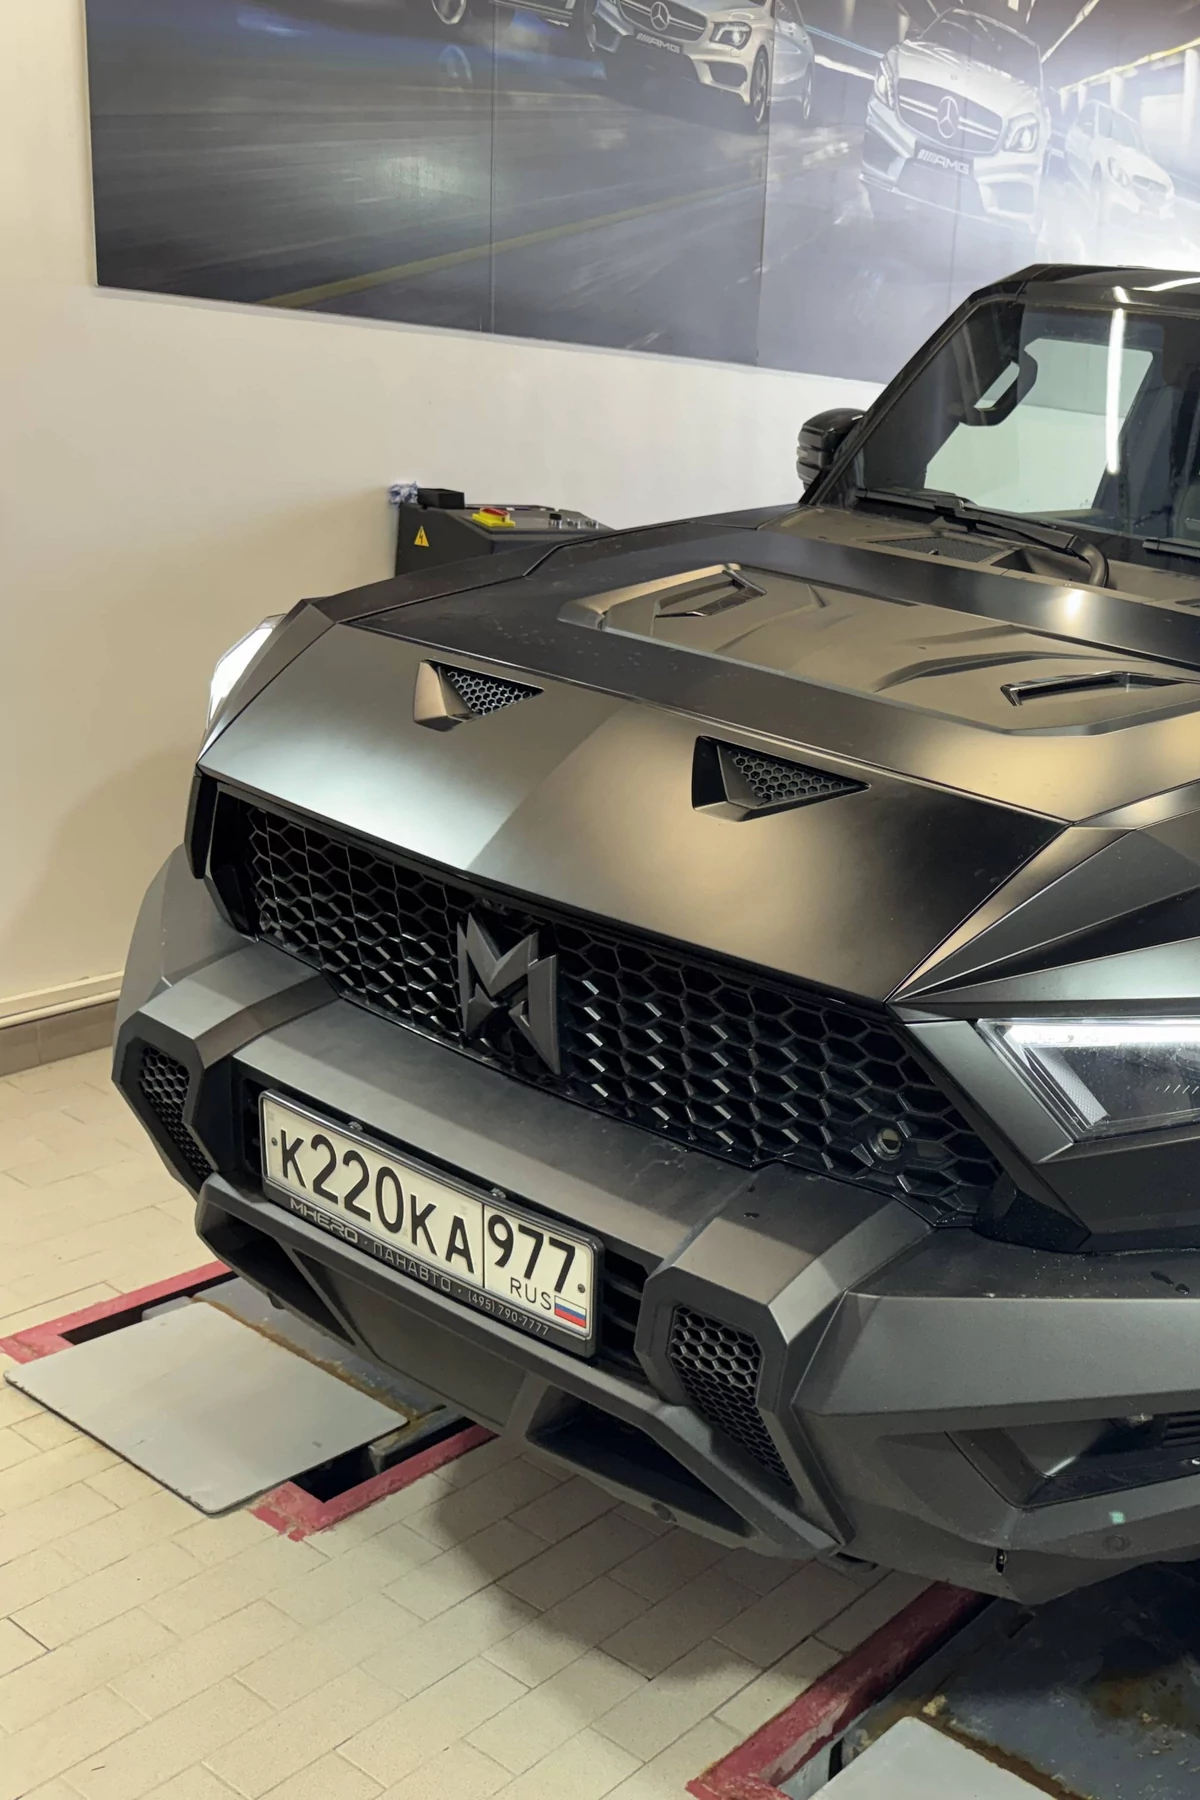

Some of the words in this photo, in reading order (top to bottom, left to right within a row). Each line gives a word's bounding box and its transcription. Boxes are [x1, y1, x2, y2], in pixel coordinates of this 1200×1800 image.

[290, 1197, 359, 1244] MHERO
[373, 1241, 452, 1293] ПАНАВТО
[487, 1213, 577, 1294] 977
[467, 1289, 496, 1313] (495)
[498, 1304, 550, 1336] 790-7777
[510, 1276, 552, 1311] RUS
